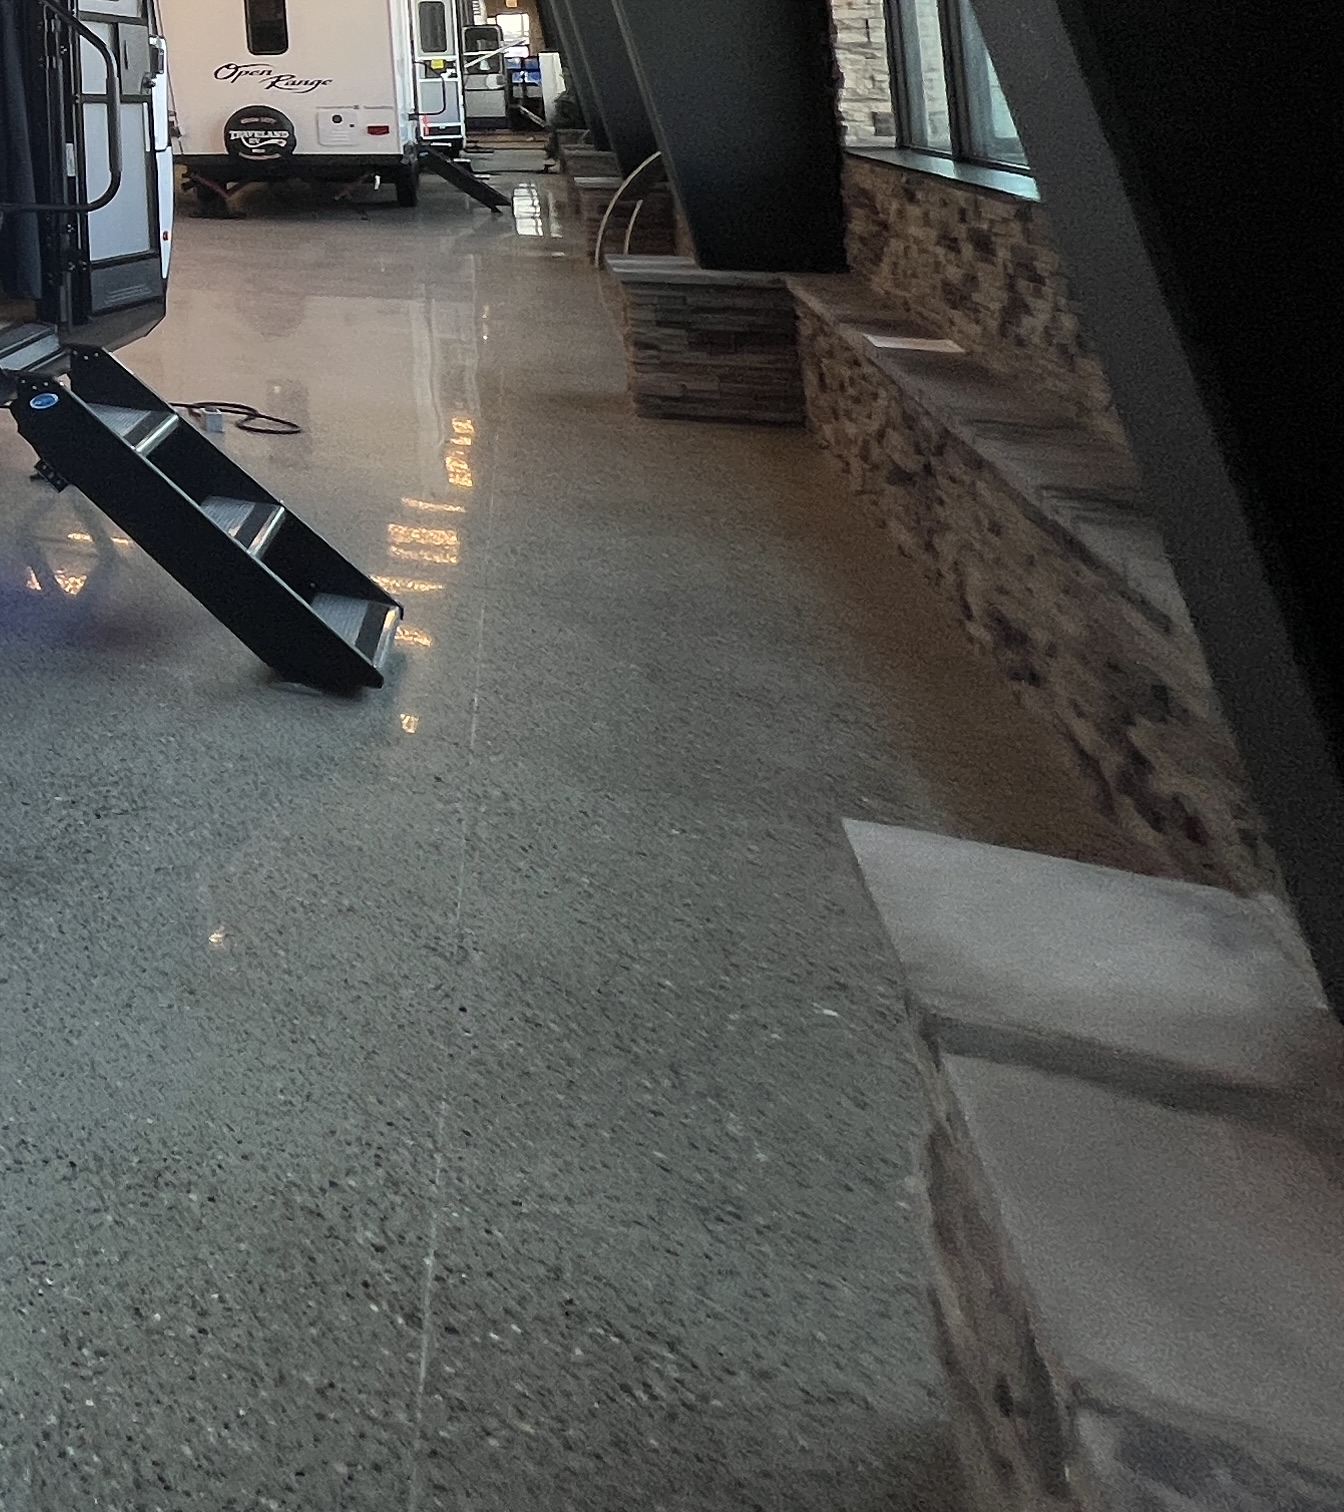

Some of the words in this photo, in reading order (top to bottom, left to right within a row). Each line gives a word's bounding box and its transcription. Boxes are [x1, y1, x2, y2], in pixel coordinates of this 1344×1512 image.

[214, 63, 274, 83] Open
[258, 74, 333, 93] Range
[229, 130, 289, 140] TRAVELAND
